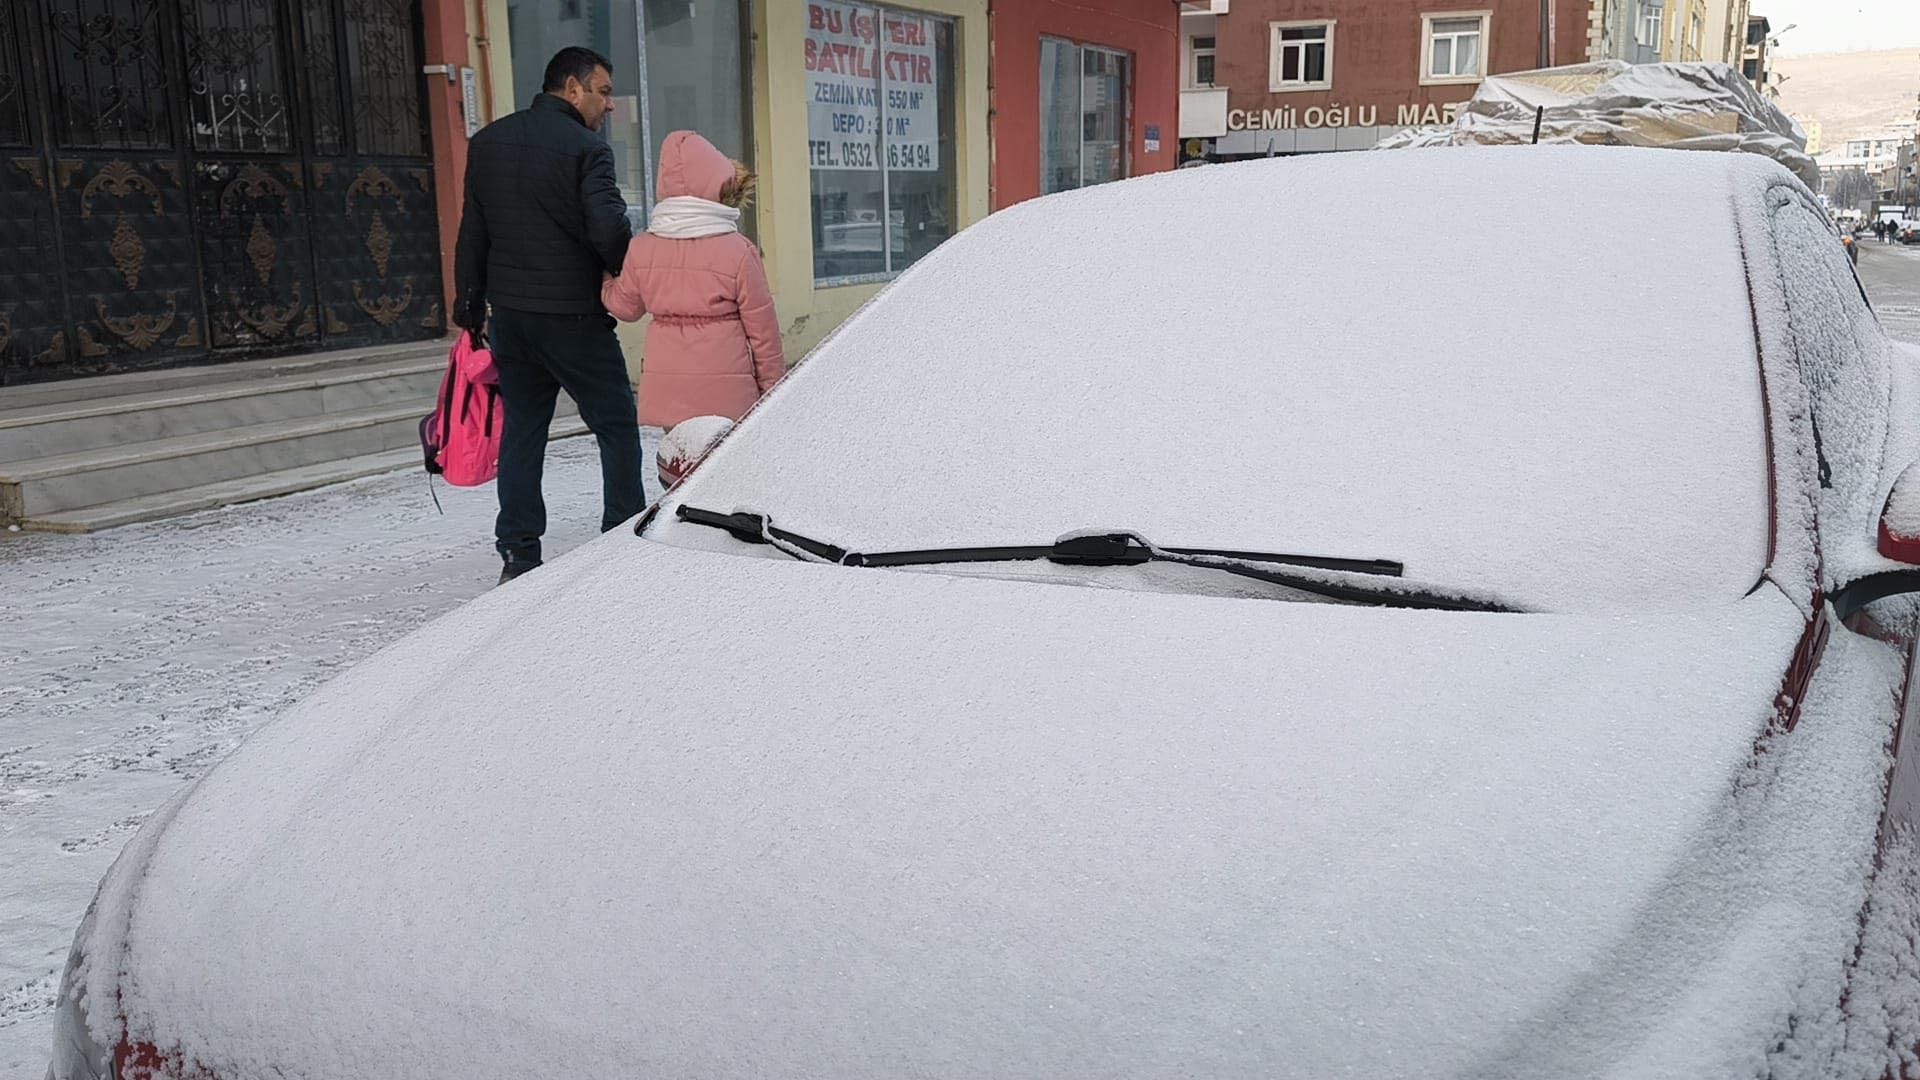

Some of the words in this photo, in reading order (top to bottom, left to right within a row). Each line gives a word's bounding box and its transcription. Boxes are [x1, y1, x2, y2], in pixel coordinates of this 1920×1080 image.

[808, 4, 842, 34] BU
[849, 8, 927, 46] İŞERİ
[814, 80, 854, 105] ZEMİN
[889, 90, 907, 110] 550
[832, 113, 864, 134] DEPO
[808, 140, 839, 166] TEL.
[842, 142, 872, 167] 0532
[901, 144, 914, 167] 54
[917, 144, 930, 168] 94
